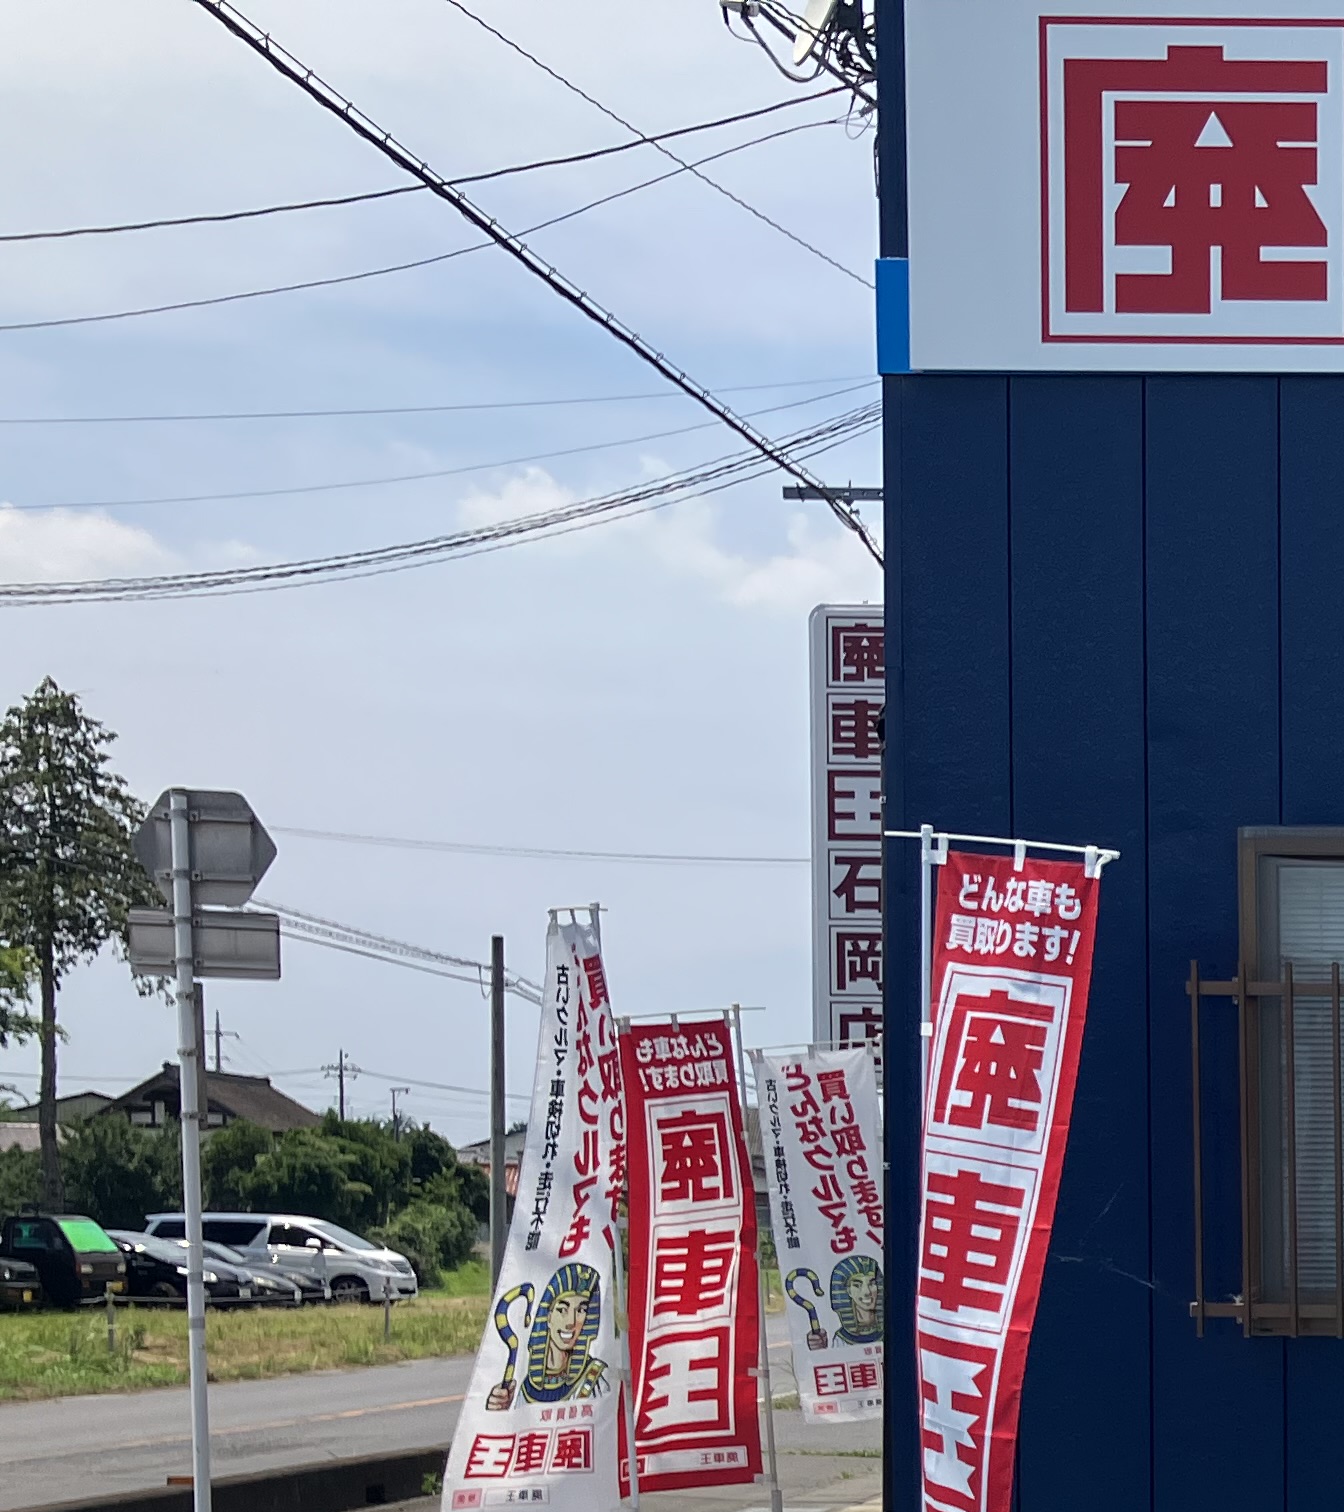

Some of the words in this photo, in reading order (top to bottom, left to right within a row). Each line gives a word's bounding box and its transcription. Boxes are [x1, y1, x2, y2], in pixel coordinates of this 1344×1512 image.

[958, 873, 1082, 921] どんな車も
[918, 980, 1059, 1512] 廃車王
